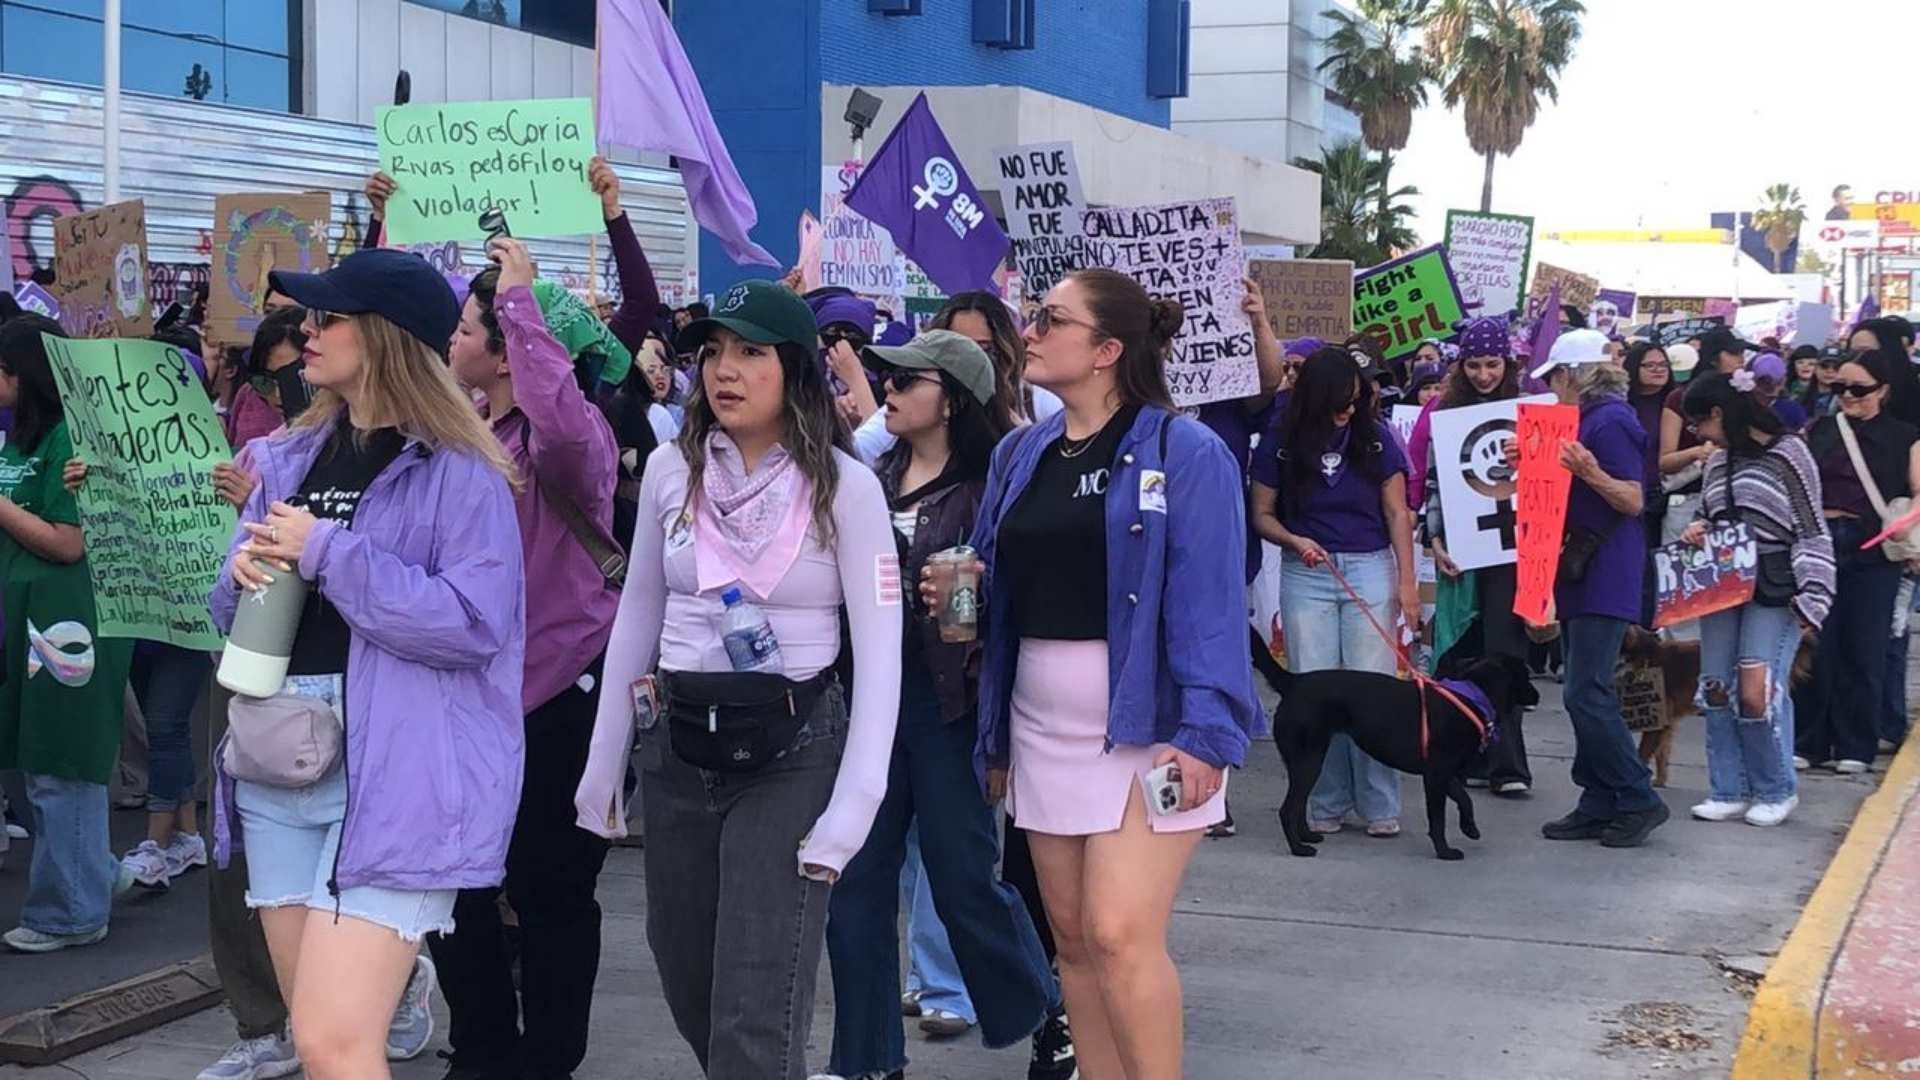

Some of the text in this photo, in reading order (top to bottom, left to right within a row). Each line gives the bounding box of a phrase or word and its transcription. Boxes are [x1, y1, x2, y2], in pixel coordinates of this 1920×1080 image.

[384, 109, 580, 146] Carlos es Coria
[999, 150, 1068, 179] NO FUE
[1014, 181, 1073, 211] AMOR
[952, 193, 984, 229] 8M
[1028, 211, 1063, 236] FUE
[1083, 206, 1209, 238] CALLADITA
[834, 239, 854, 263] NO
[1012, 234, 1083, 257] MANIPULACI
[1086, 242, 1116, 268] NO
[1119, 242, 1154, 266] TE
[1158, 238, 1204, 264] VES
[821, 262, 894, 288] FEMINISMO
[1018, 252, 1086, 278] VIOLENCI
[1476, 273, 1512, 289] ELLAS
[1354, 287, 1423, 326] like a
